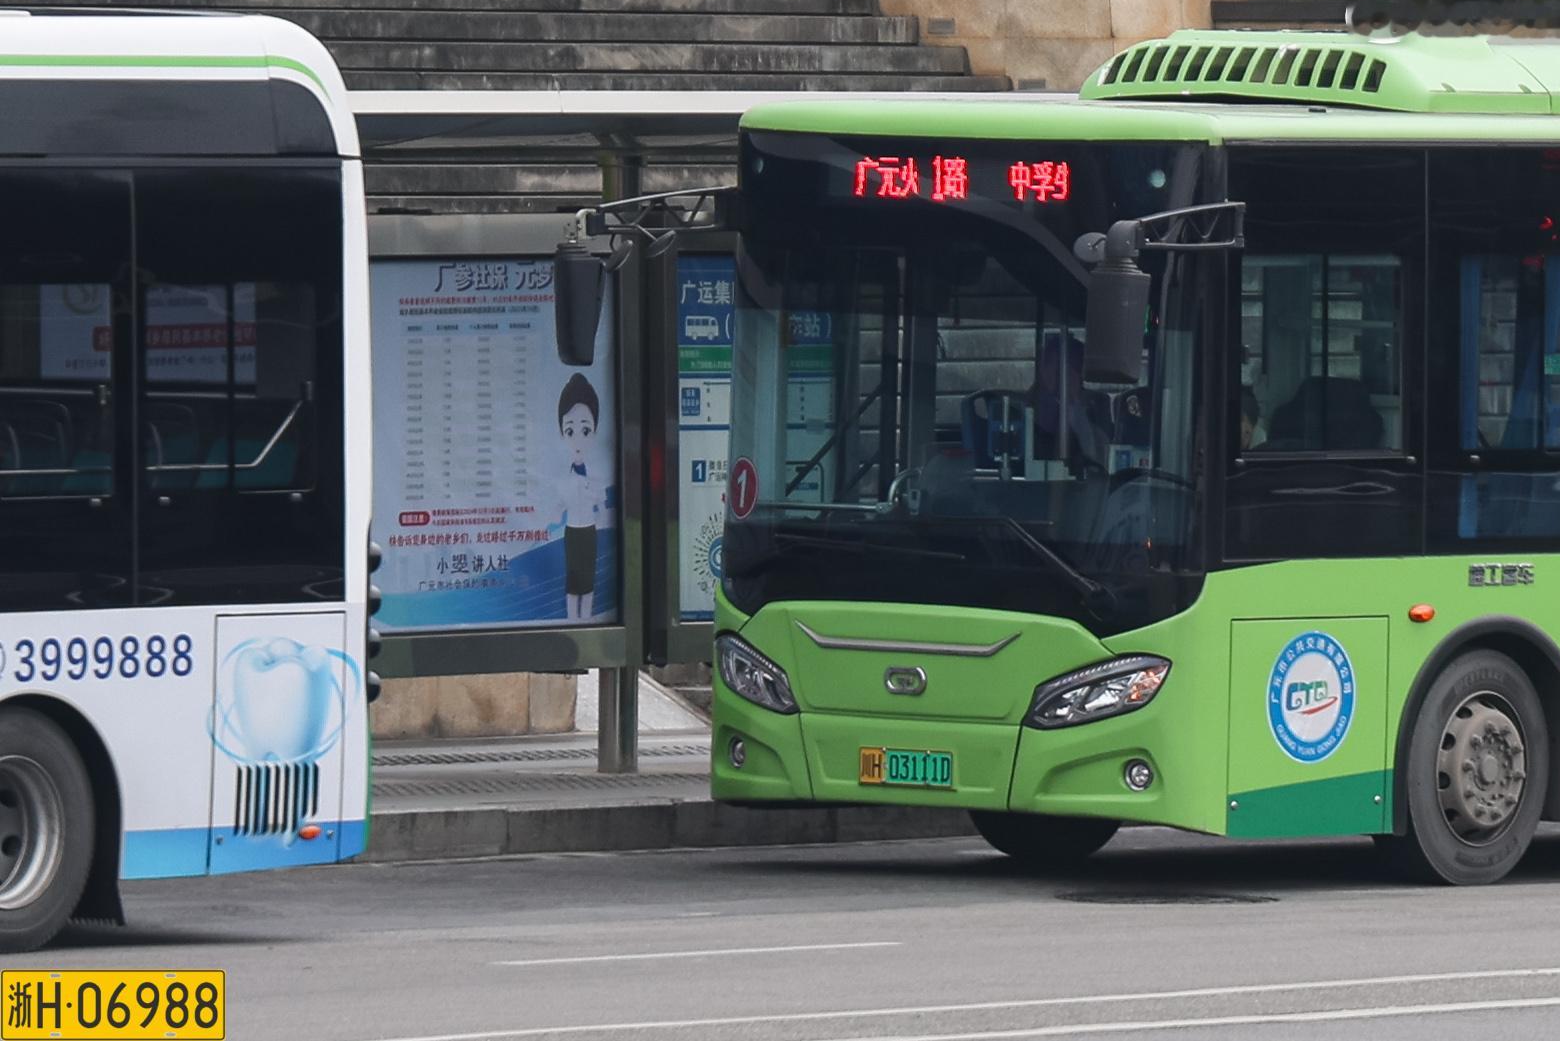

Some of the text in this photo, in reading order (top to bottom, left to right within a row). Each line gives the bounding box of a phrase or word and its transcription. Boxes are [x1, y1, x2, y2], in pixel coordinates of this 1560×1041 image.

[681, 280, 735, 305] 广运集
[737, 469, 748, 508] 1
